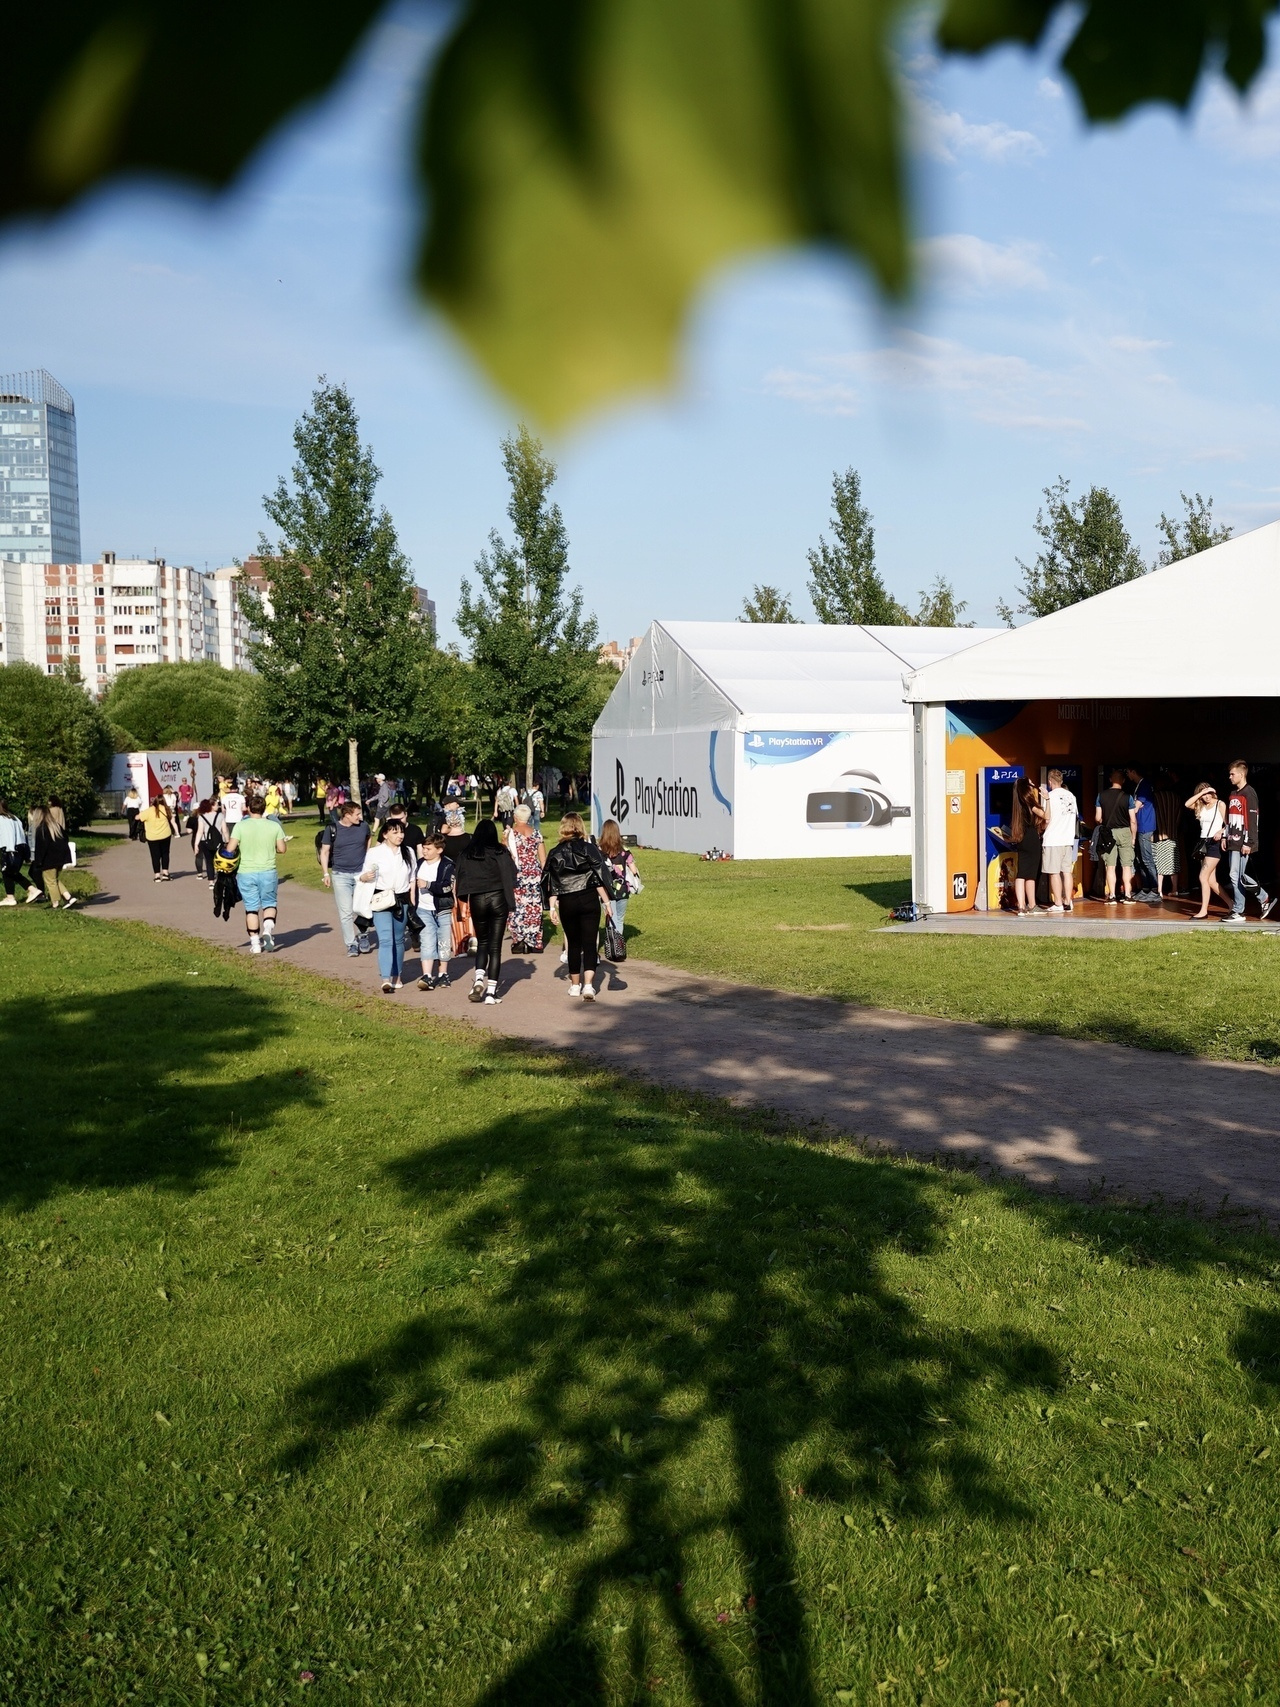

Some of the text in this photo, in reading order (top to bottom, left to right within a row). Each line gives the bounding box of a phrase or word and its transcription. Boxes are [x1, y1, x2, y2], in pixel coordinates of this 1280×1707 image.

[1058, 704, 1090, 719] MORTAL
[1099, 705, 1132, 720] KOMBAT
[768, 738, 811, 748] PlayStation
[160, 774, 177, 782] ACTIVE
[1001, 771, 1018, 779] PS4
[228, 800, 237, 809] 12
[634, 776, 698, 828] PlayStation
